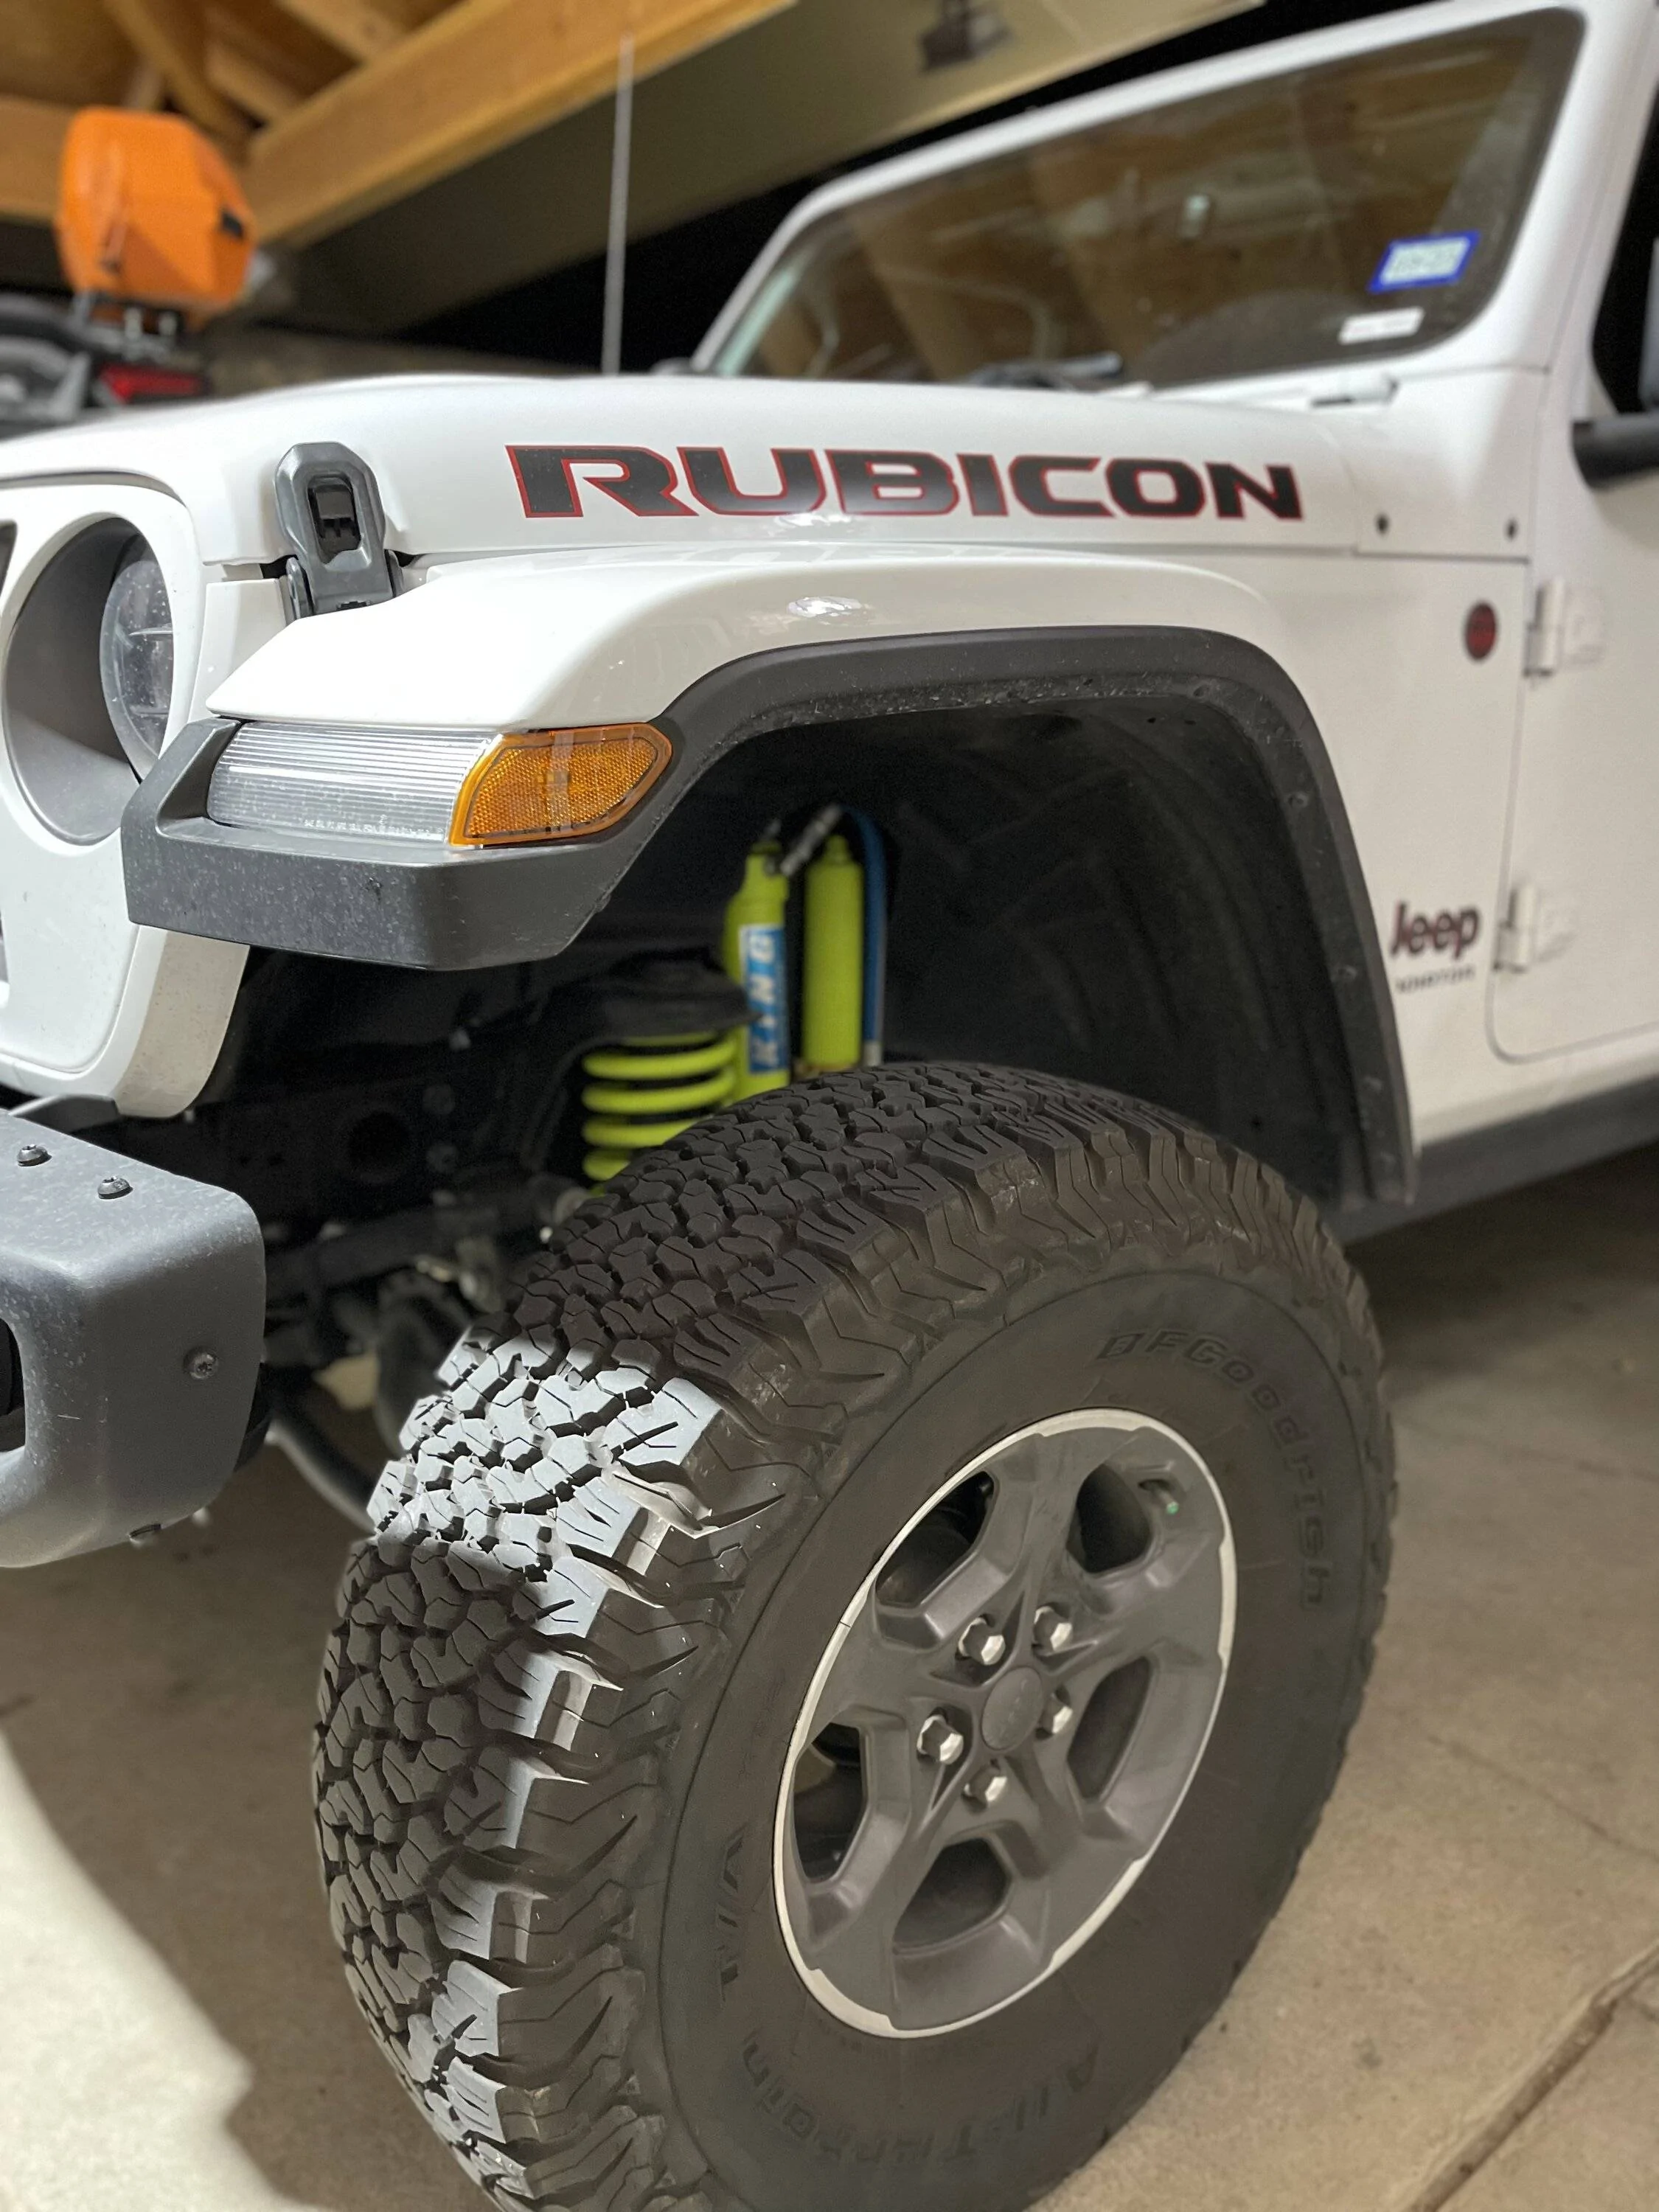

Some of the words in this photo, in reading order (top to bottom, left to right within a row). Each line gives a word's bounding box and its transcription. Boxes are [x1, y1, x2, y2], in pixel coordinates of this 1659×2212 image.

[505, 445, 1303, 520] RUBICON
[1391, 900, 1480, 960] Jeep
[1094, 1329, 1329, 1606] BFGoodrich
